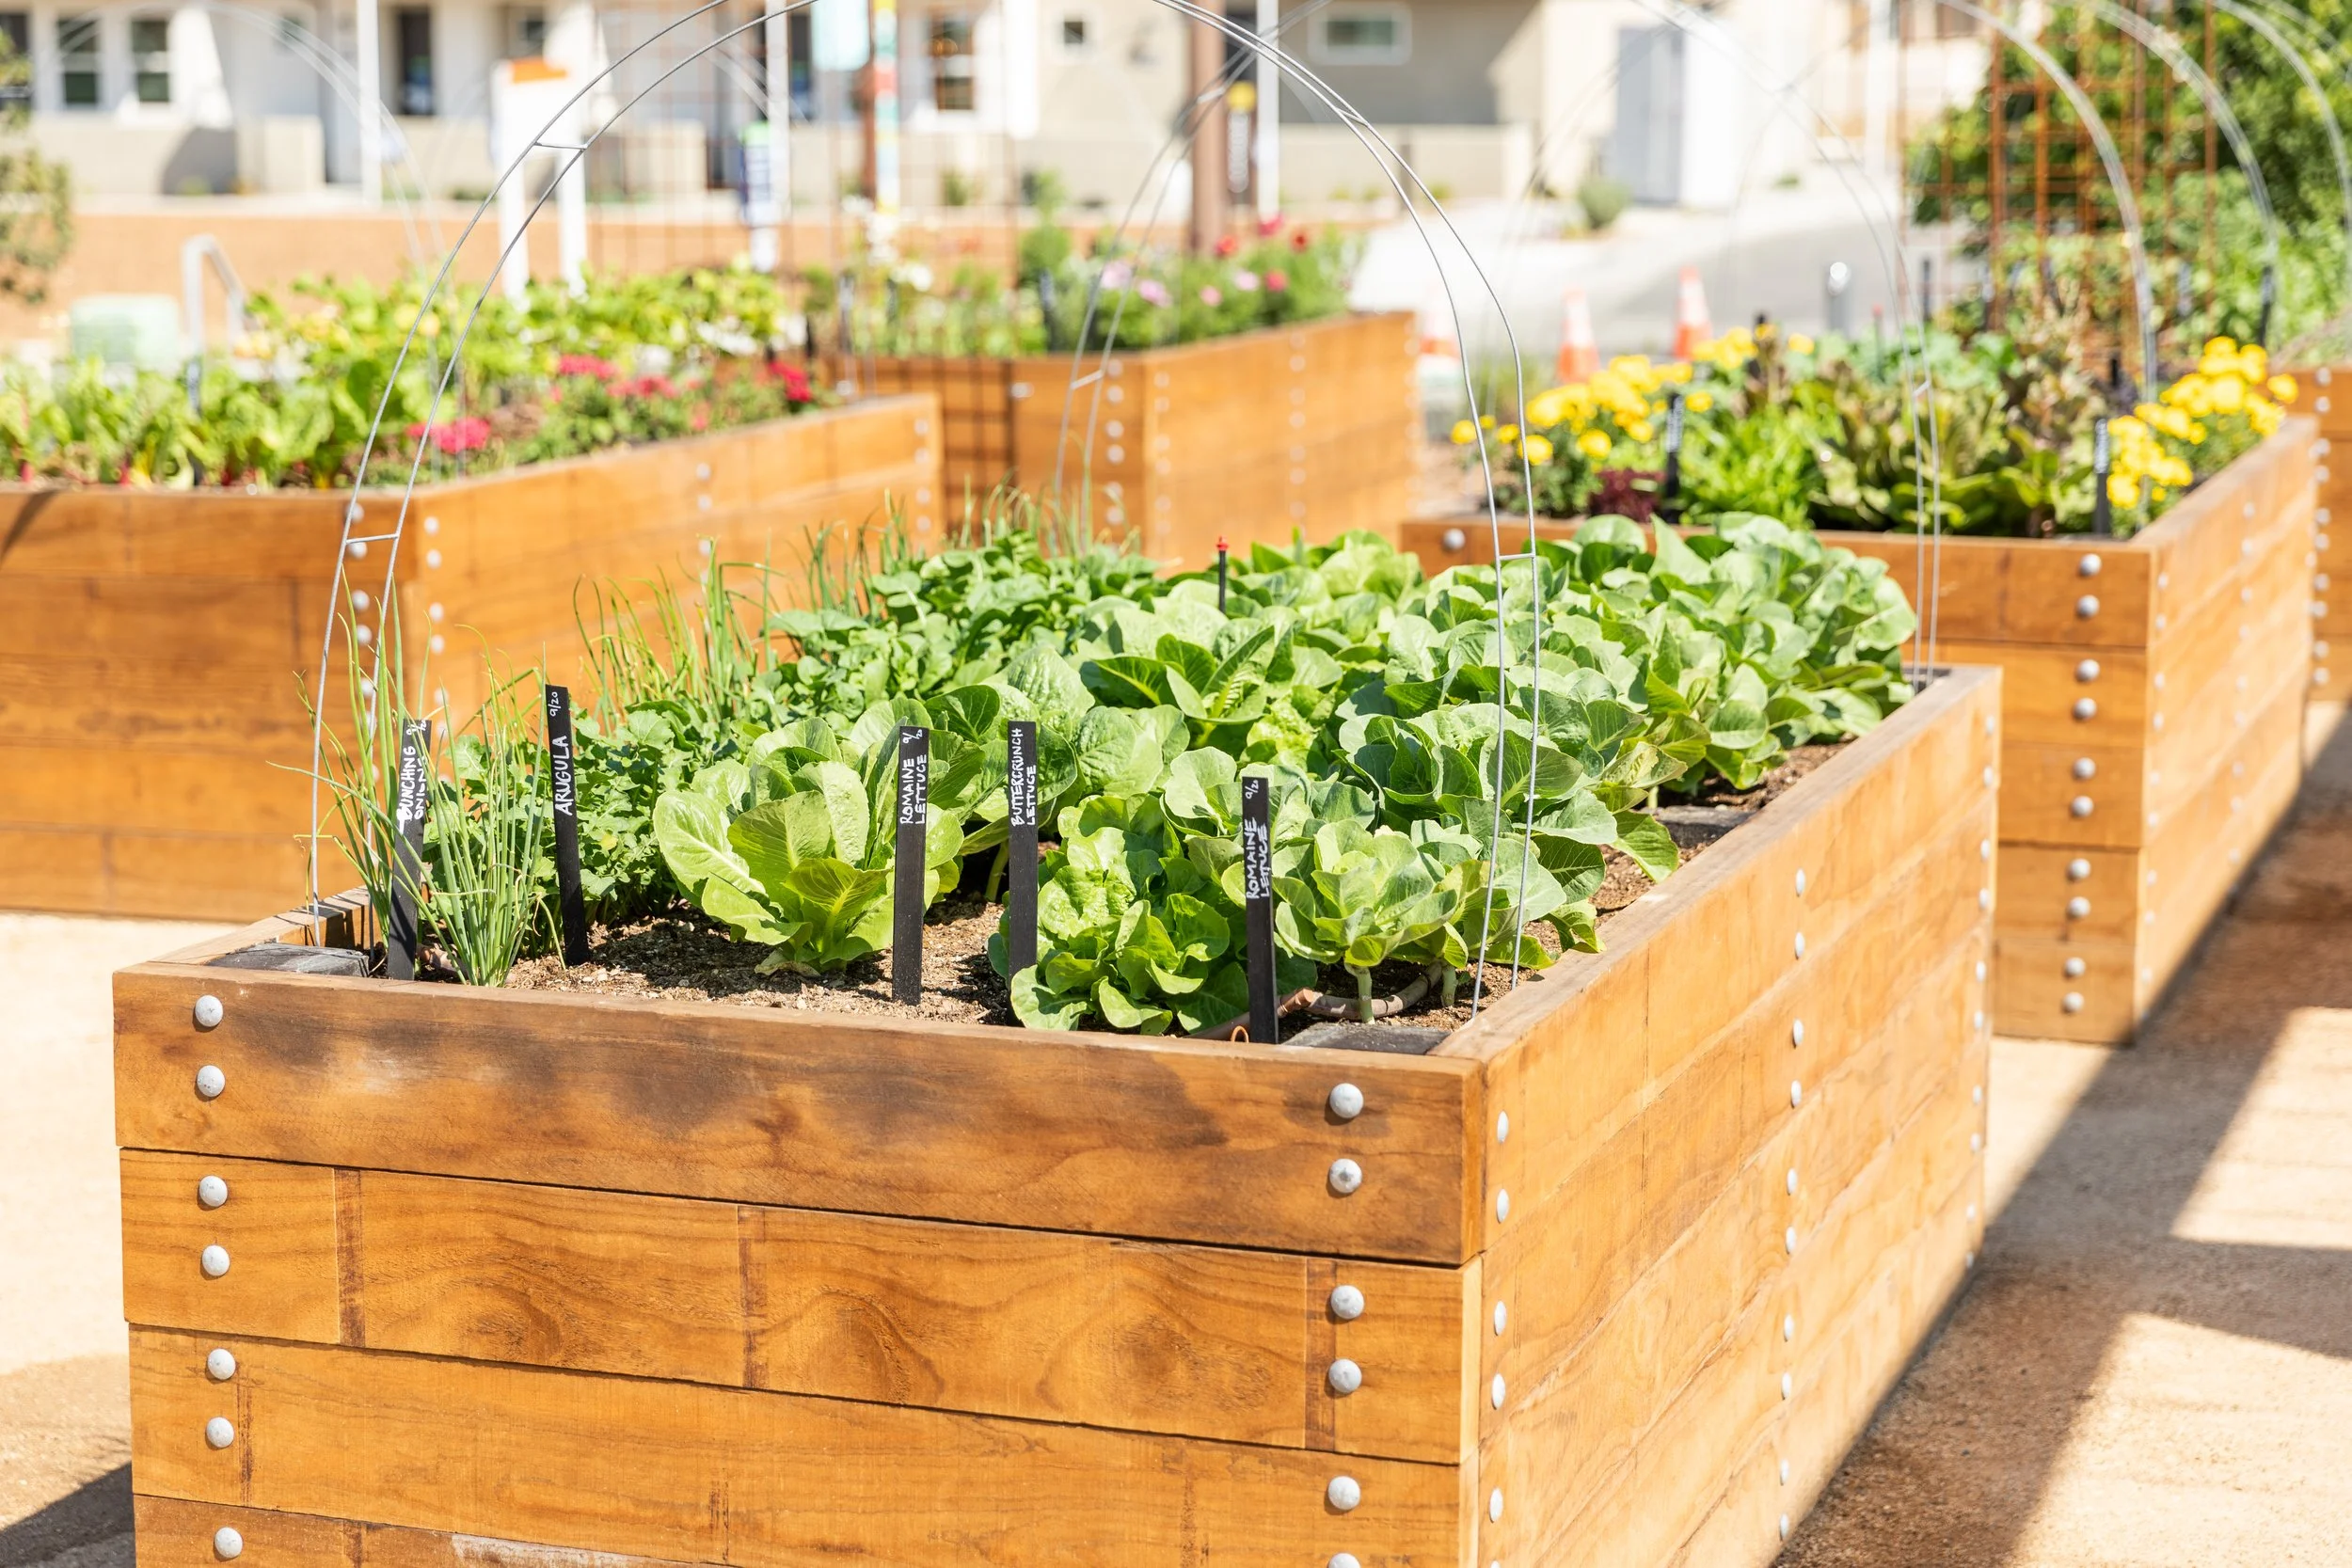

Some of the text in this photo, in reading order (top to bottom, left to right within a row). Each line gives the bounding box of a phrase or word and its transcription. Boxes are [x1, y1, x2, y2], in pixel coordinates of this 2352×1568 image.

[552, 735, 574, 816] ARUGULA
[900, 758, 914, 824] ROMAINE
[914, 754, 927, 825] LETTUCE
[1010, 727, 1025, 827] BUTTERCRUNCH
[1244, 816, 1260, 899] ROMAINE
[1257, 823, 1271, 897] LETTUCE
